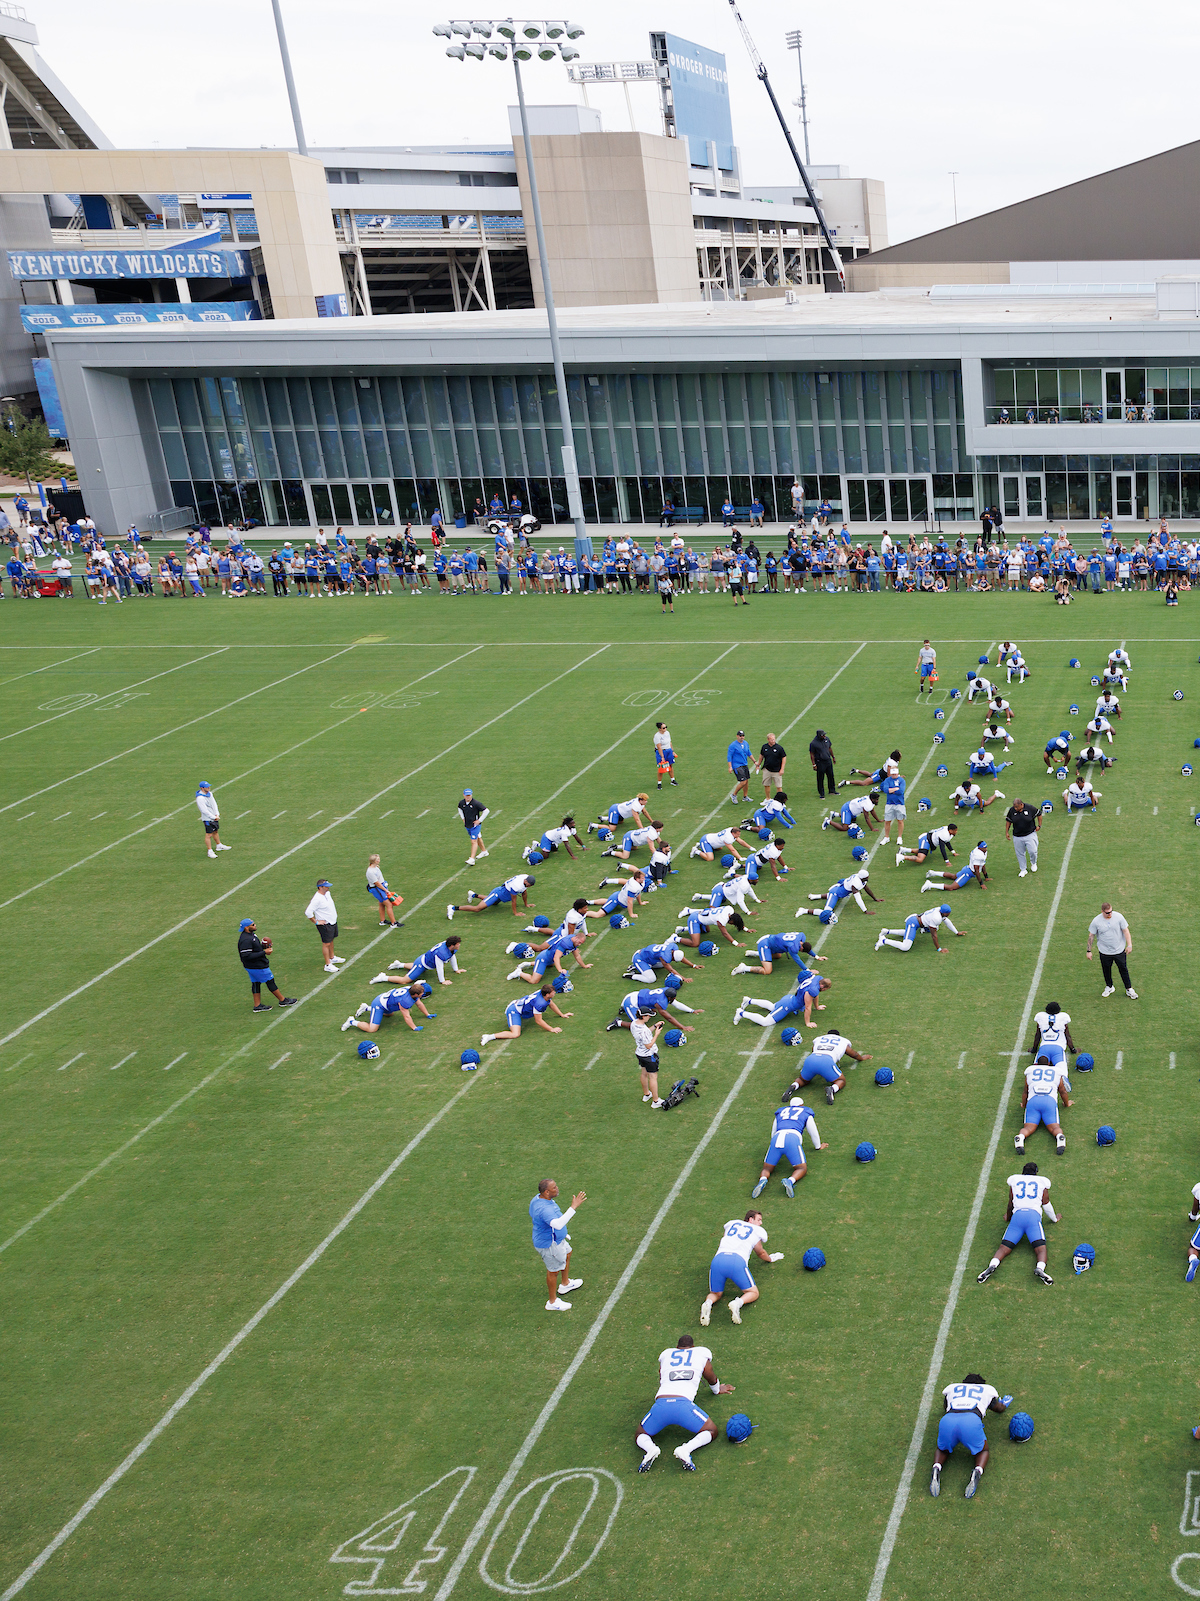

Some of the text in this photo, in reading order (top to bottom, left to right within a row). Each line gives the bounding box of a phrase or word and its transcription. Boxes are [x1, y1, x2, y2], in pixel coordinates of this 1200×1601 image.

[675, 54, 723, 82] KROGER FIELD
[10, 254, 223, 275] KENTUCKY WILDCATS
[820, 1036, 841, 1046] 52
[1031, 1068, 1056, 1083] 99
[780, 1106, 805, 1121] 47
[1015, 1180, 1039, 1200] 33
[726, 1222, 755, 1241] 63
[669, 1349, 695, 1367] 51
[952, 1385, 985, 1402] 92
[328, 1465, 625, 1595] 40
